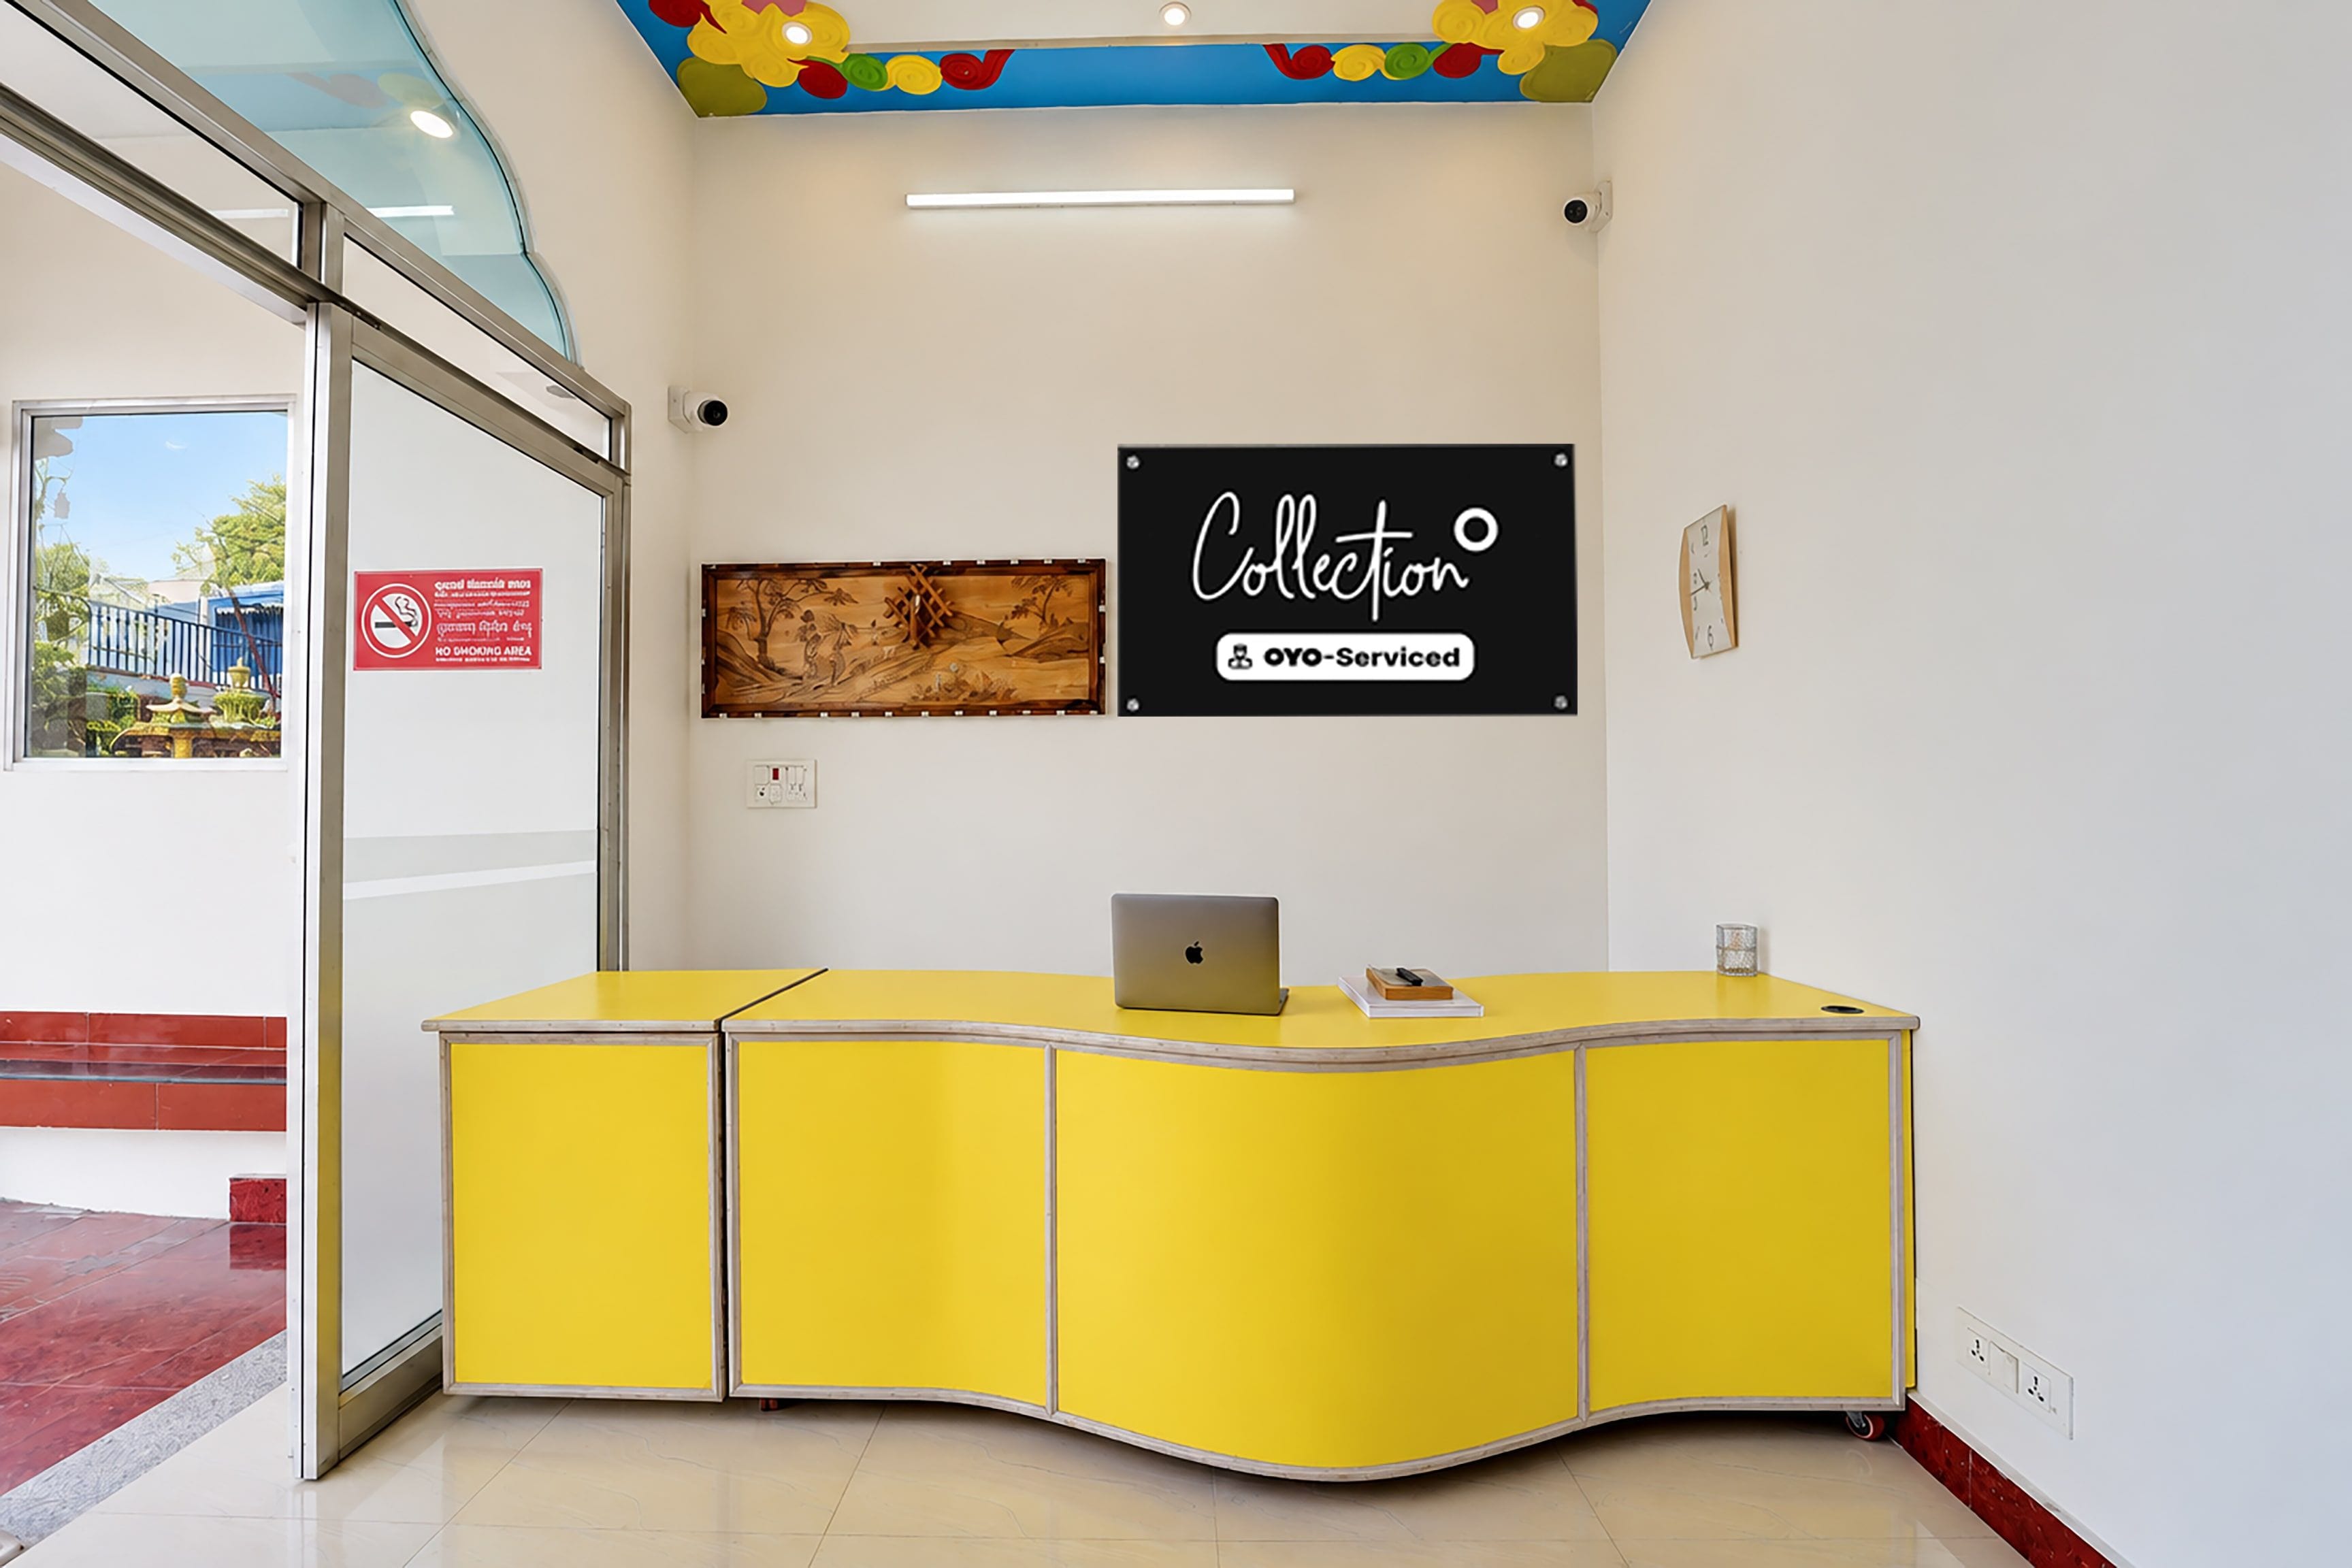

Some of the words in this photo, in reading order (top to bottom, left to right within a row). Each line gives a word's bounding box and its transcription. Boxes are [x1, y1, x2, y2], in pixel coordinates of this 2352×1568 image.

[1192, 491, 1469, 621] Collection
[435, 646, 451, 656] NO
[504, 645, 532, 656] AREA
[1264, 646, 1460, 667] OYO-Serviced
